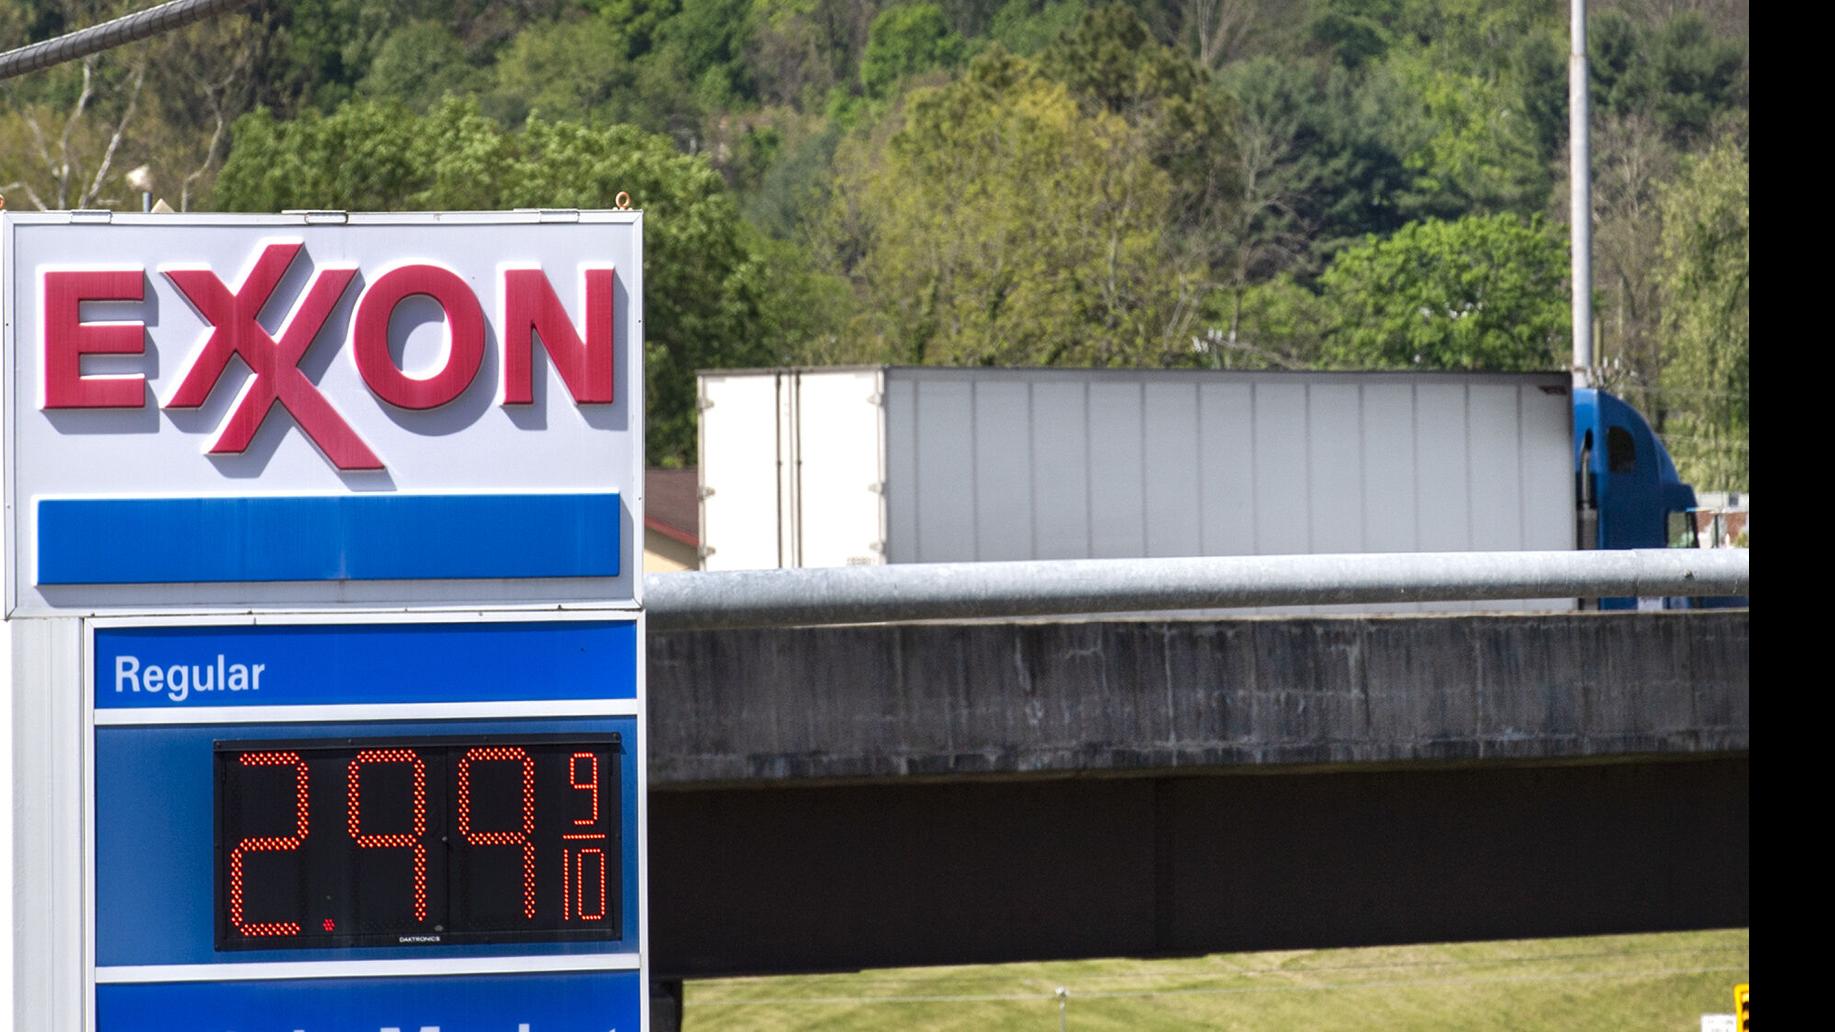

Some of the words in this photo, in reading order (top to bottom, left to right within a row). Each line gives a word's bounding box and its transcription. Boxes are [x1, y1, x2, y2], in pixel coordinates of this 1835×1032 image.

[41, 241, 615, 471] EXXON
[115, 654, 265, 702] Regular
[569, 752, 599, 826] 9
[231, 747, 536, 937] 2.99
[563, 848, 606, 921] 10
